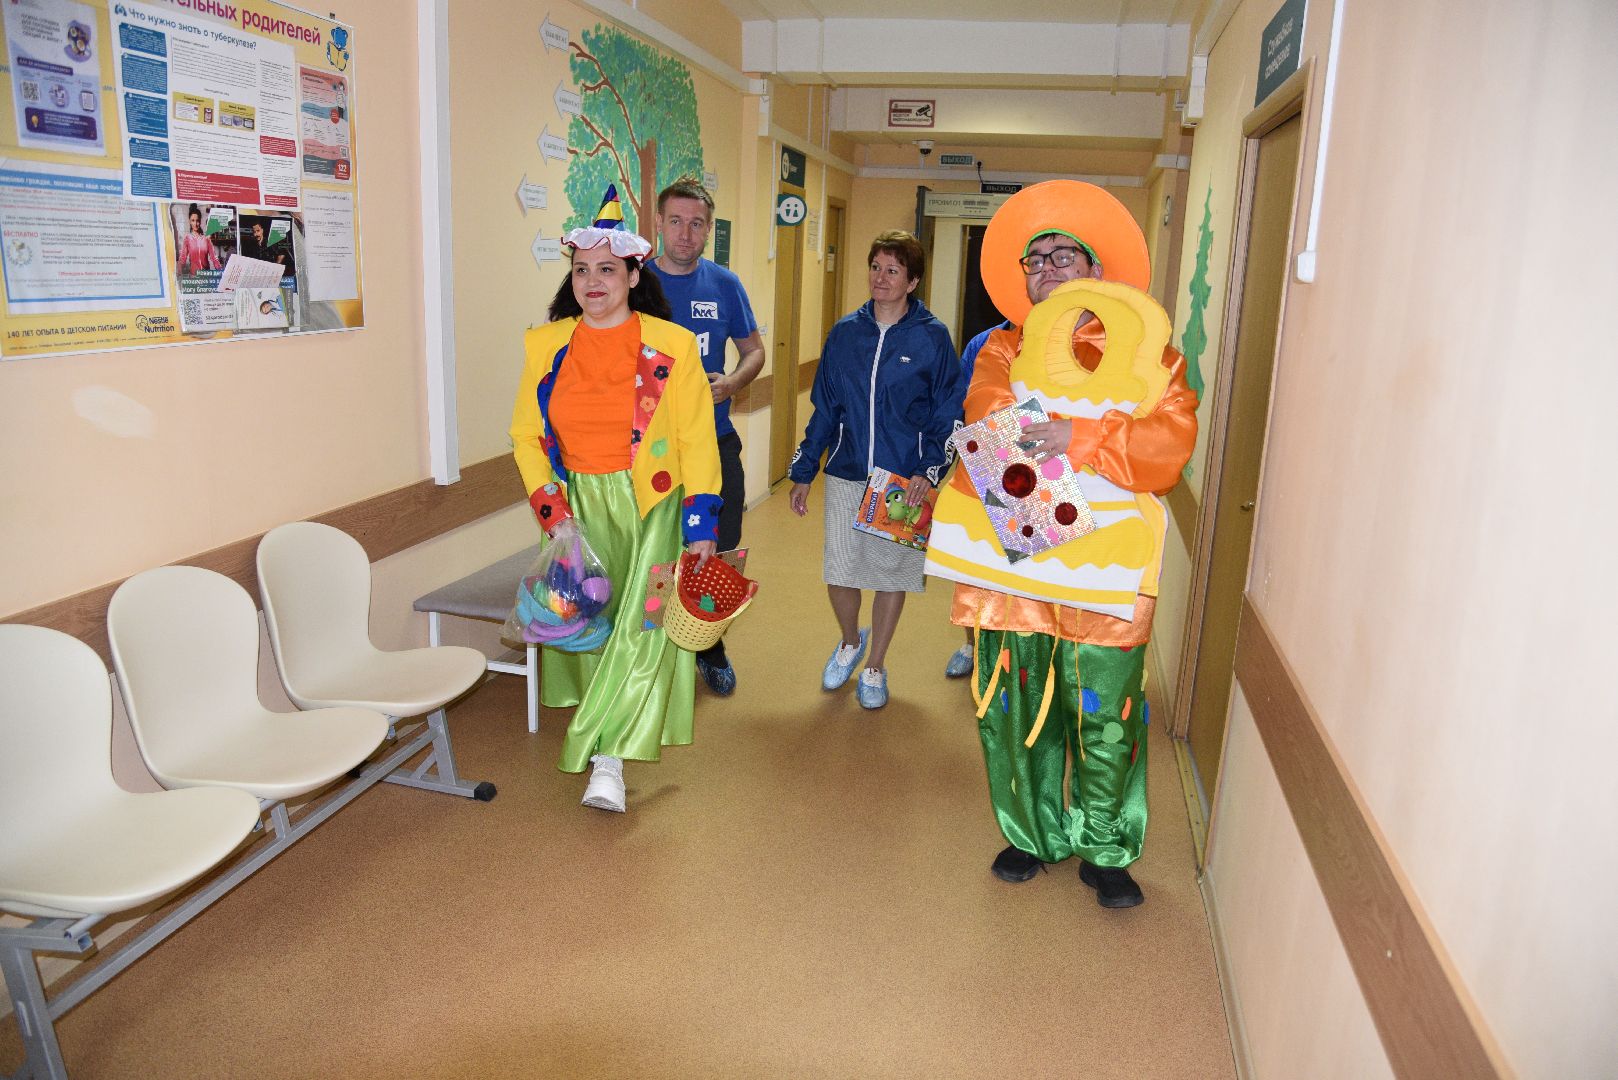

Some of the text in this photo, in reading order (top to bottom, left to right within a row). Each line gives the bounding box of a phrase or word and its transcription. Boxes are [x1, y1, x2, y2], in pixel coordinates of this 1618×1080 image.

[128, 7, 146, 21] Что
[148, 15, 177, 28] нужно
[178, 23, 201, 35] знать
[210, 31, 257, 50] туберкулезе?
[242, 9, 321, 46] родителей
[942, 156, 971, 165] ВЫХОД
[986, 185, 1017, 193] ВЫХОД
[36, 328, 59, 336] ОПЫТА
[67, 326, 96, 335] ДЕТСКОМ
[97, 324, 127, 332] ПИТАНИИ
[144, 325, 174, 333] Nutrition
